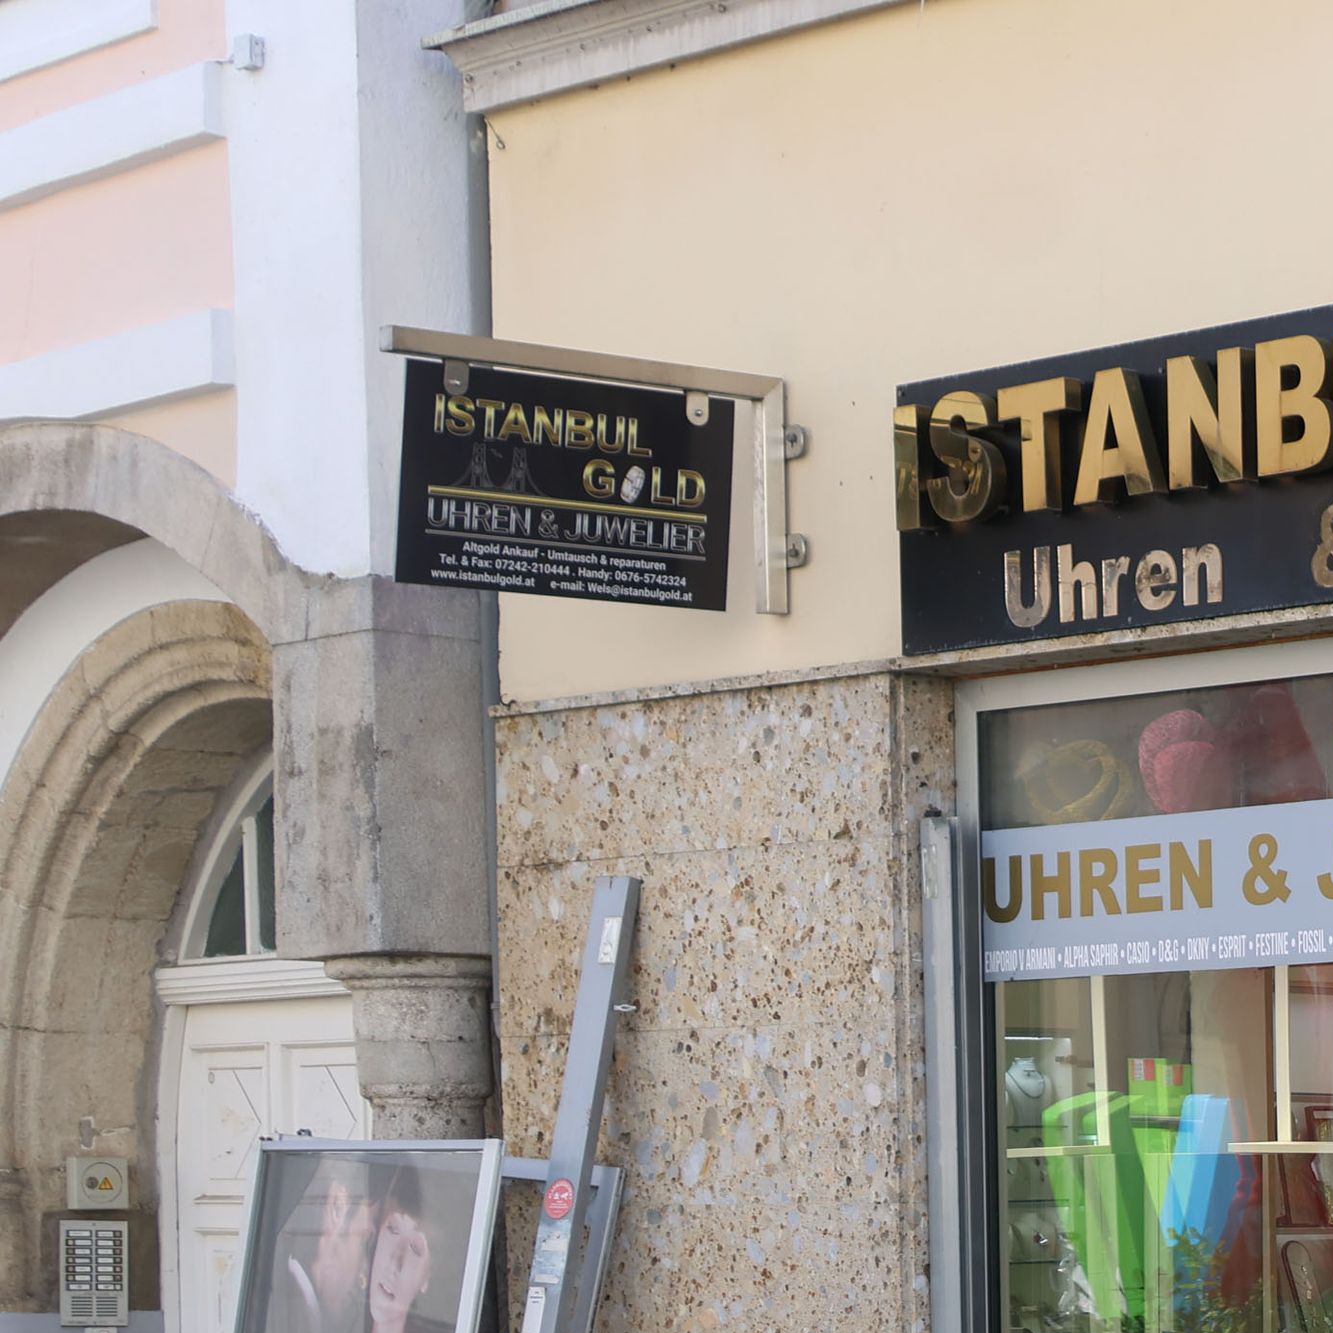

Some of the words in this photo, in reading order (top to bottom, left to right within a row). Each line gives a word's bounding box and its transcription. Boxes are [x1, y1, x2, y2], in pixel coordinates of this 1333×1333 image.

[434, 393, 652, 457] ISTANBUL
[427, 497, 531, 536] UHREN
[538, 509, 559, 539] &
[563, 513, 706, 554] JUWELIER
[439, 553, 458, 566] Tel.
[461, 556, 469, 566] &
[471, 556, 493, 568] Fax:
[495, 559, 570, 576] 07242-210444
[578, 568, 612, 582] Handy:
[614, 570, 686, 587] 0676-5742324
[462, 541, 500, 555] Altgold
[502, 545, 539, 559] Ankauf
[547, 550, 598, 564] Umtausch
[600, 555, 607, 565] &
[609, 557, 666, 571] reparaturen
[431, 569, 535, 587] www.istanbulgold.at
[550, 580, 585, 592] e-mail:
[587, 582, 693, 601] Wels@istanbulgold.at
[1003, 536, 1223, 628] Uhren
[982, 838, 1213, 923] UHREN
[1241, 833, 1293, 906] &
[984, 950, 1017, 973] EMPORIO
[1026, 947, 1056, 970] ARMANI
[1063, 946, 1088, 969] ALPHA
[1089, 944, 1119, 967] SAPHIR
[1126, 942, 1150, 964] CASIO
[1158, 940, 1179, 963] D&G
[1187, 937, 1209, 960] DKNY
[1218, 935, 1246, 959] ESPRIT
[1255, 932, 1289, 956] FESTINE
[1298, 929, 1326, 954] FOSSIL
